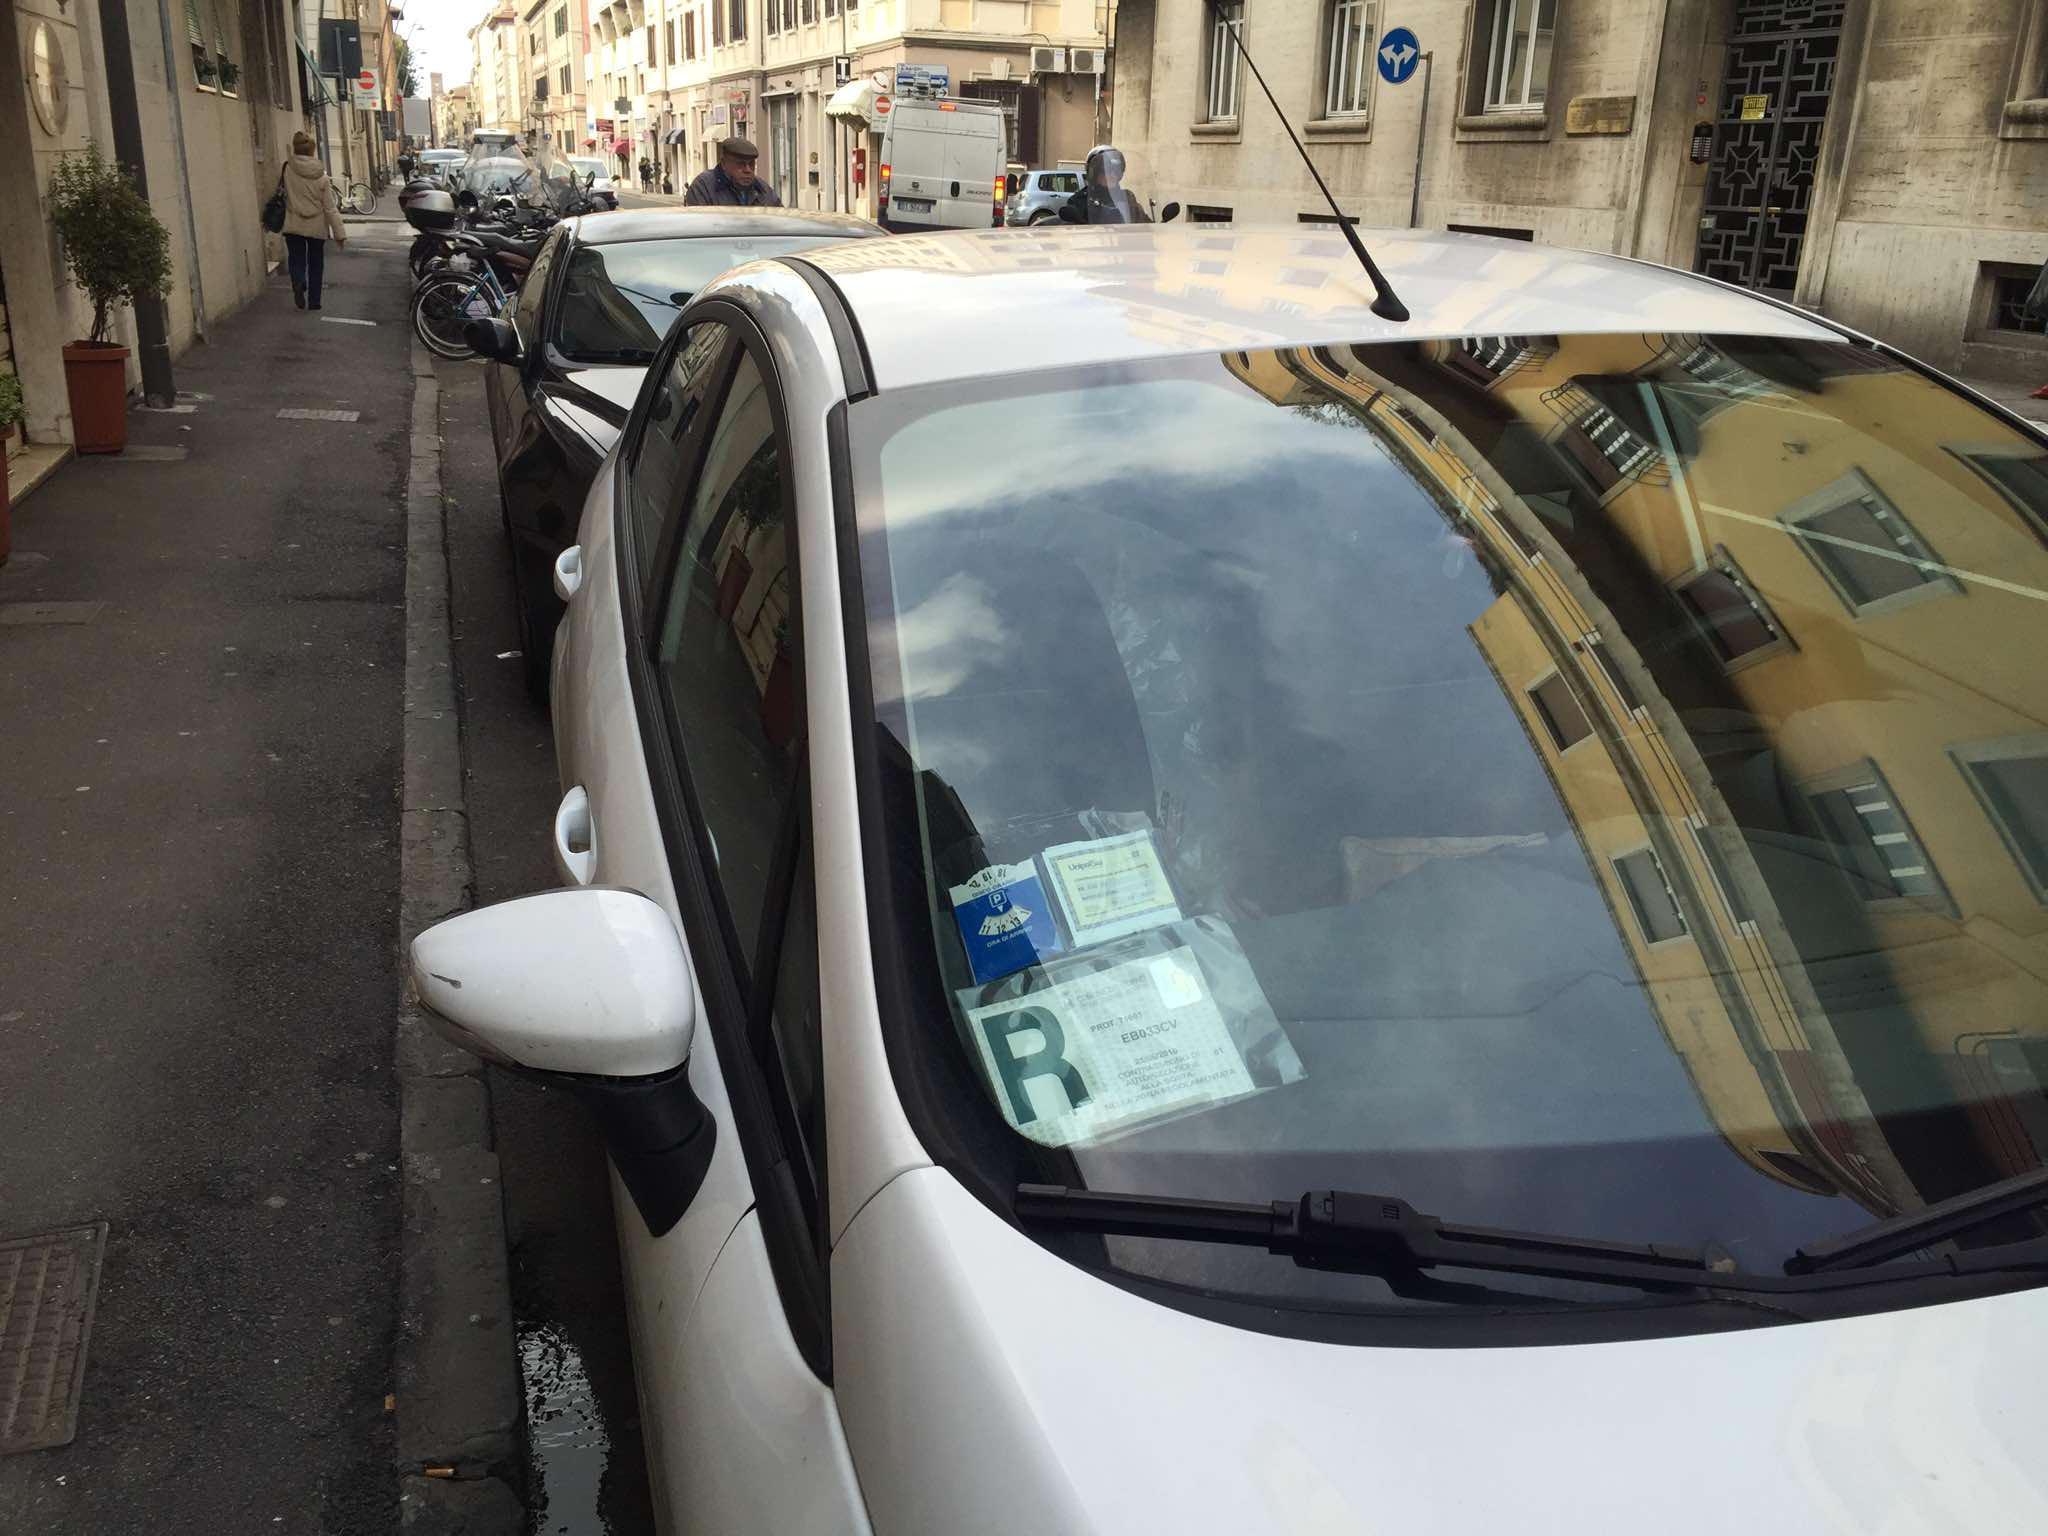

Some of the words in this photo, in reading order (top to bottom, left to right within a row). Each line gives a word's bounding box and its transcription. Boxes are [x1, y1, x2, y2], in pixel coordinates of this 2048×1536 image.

[993, 893, 1001, 904] P
[1121, 1019, 1177, 1043] EB033CV
[981, 1006, 1094, 1126] R
